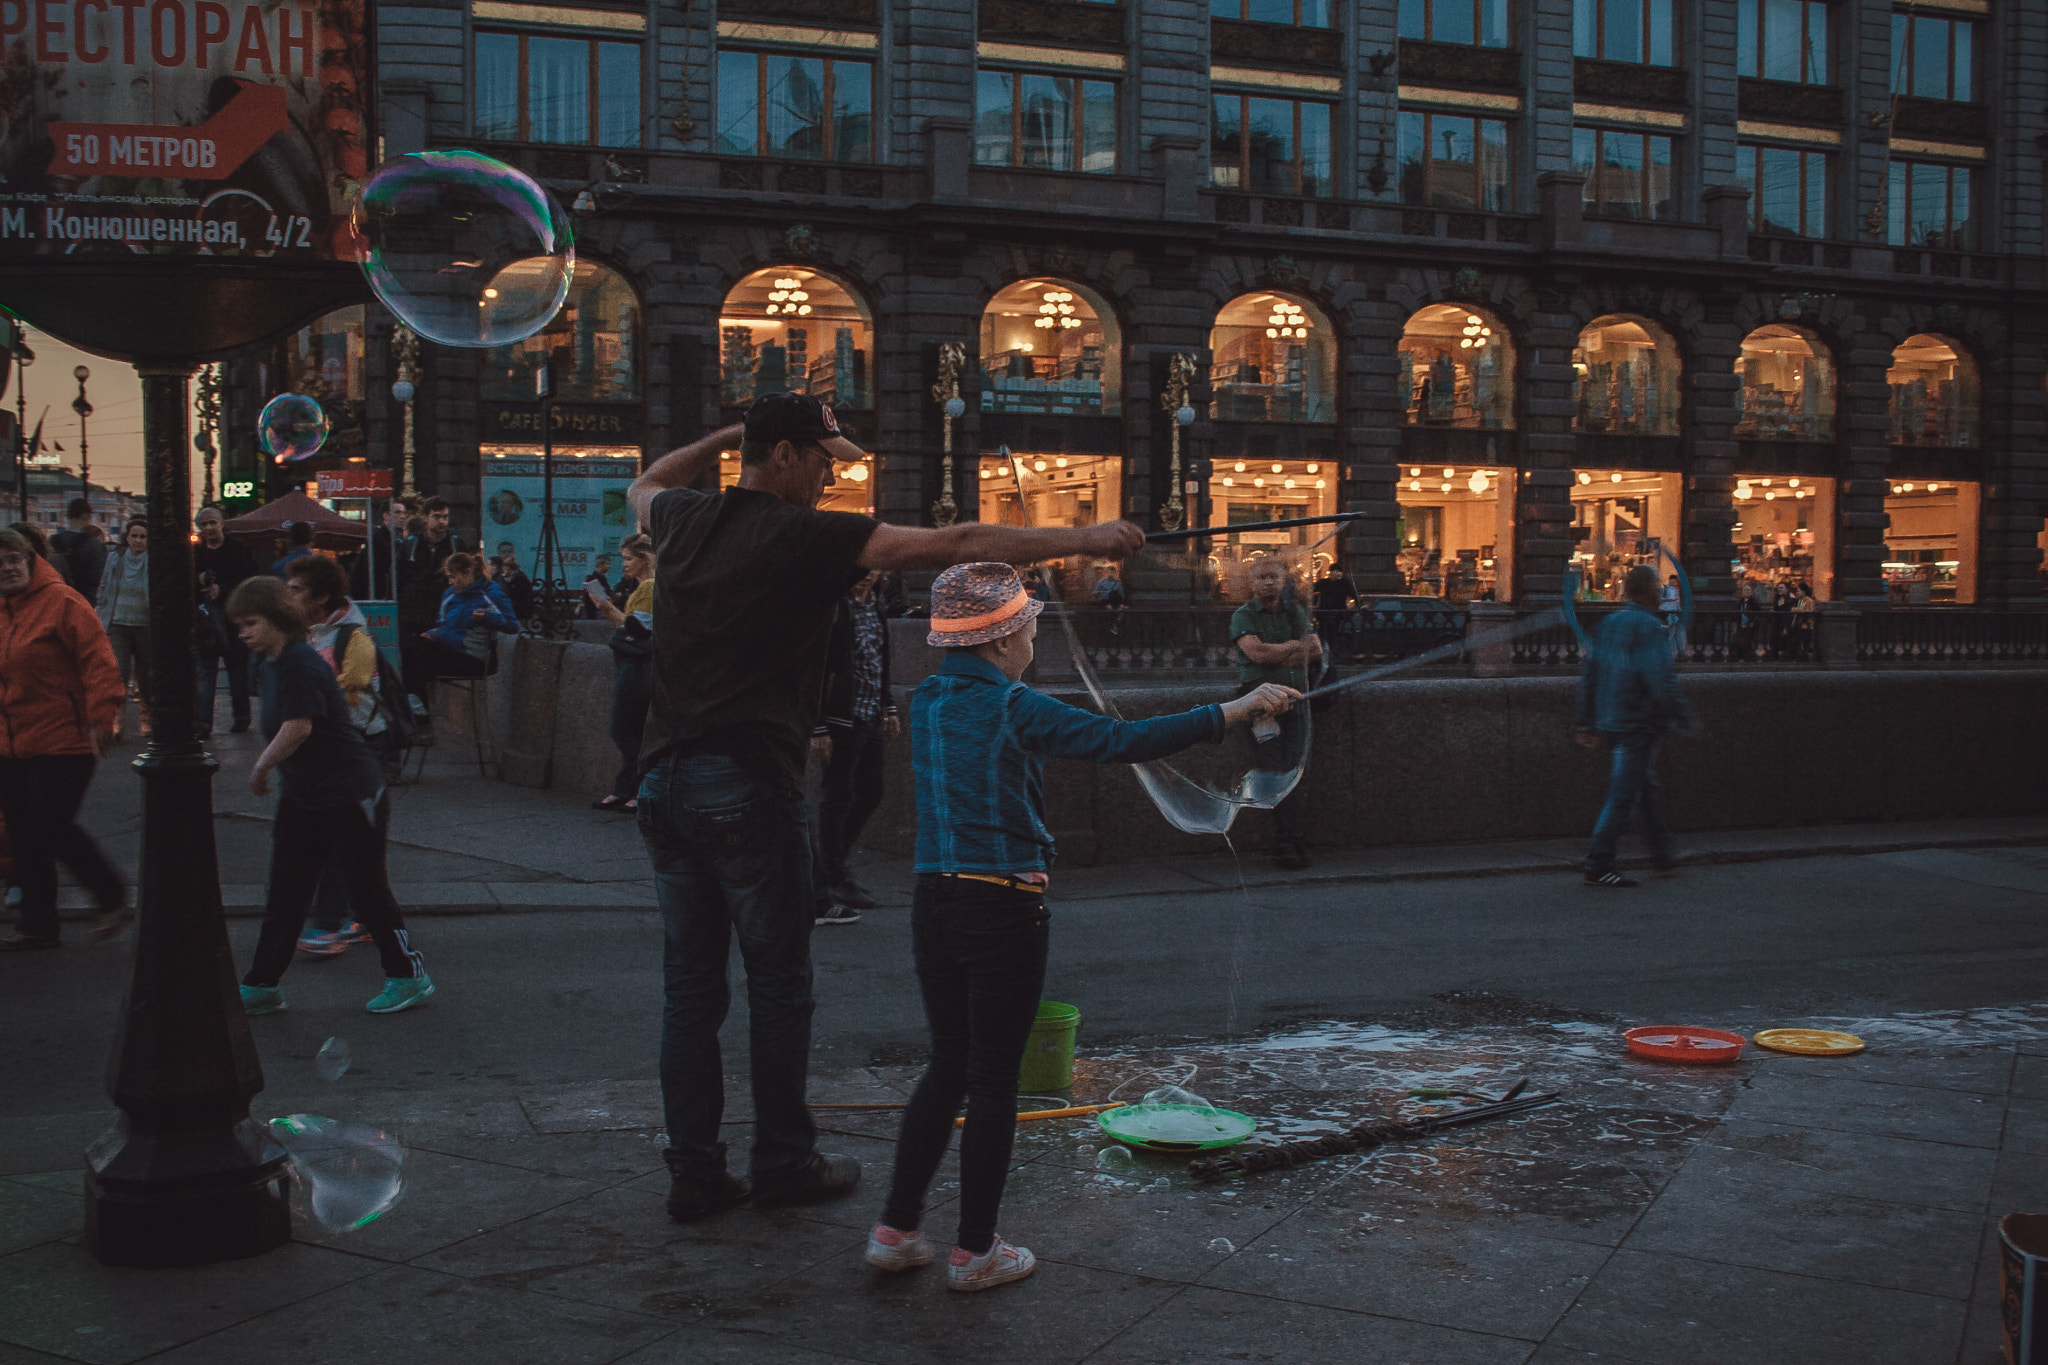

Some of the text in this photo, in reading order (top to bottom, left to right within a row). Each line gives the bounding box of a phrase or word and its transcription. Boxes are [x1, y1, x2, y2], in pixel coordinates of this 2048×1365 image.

[0, 0, 314, 78] РЕСТОРАН
[66, 134, 217, 168] 50 МЕТРОВ
[2, 207, 312, 250] М. Конюшенная, 4/2
[499, 410, 542, 431] CAFE
[557, 503, 588, 515] МАЯ
